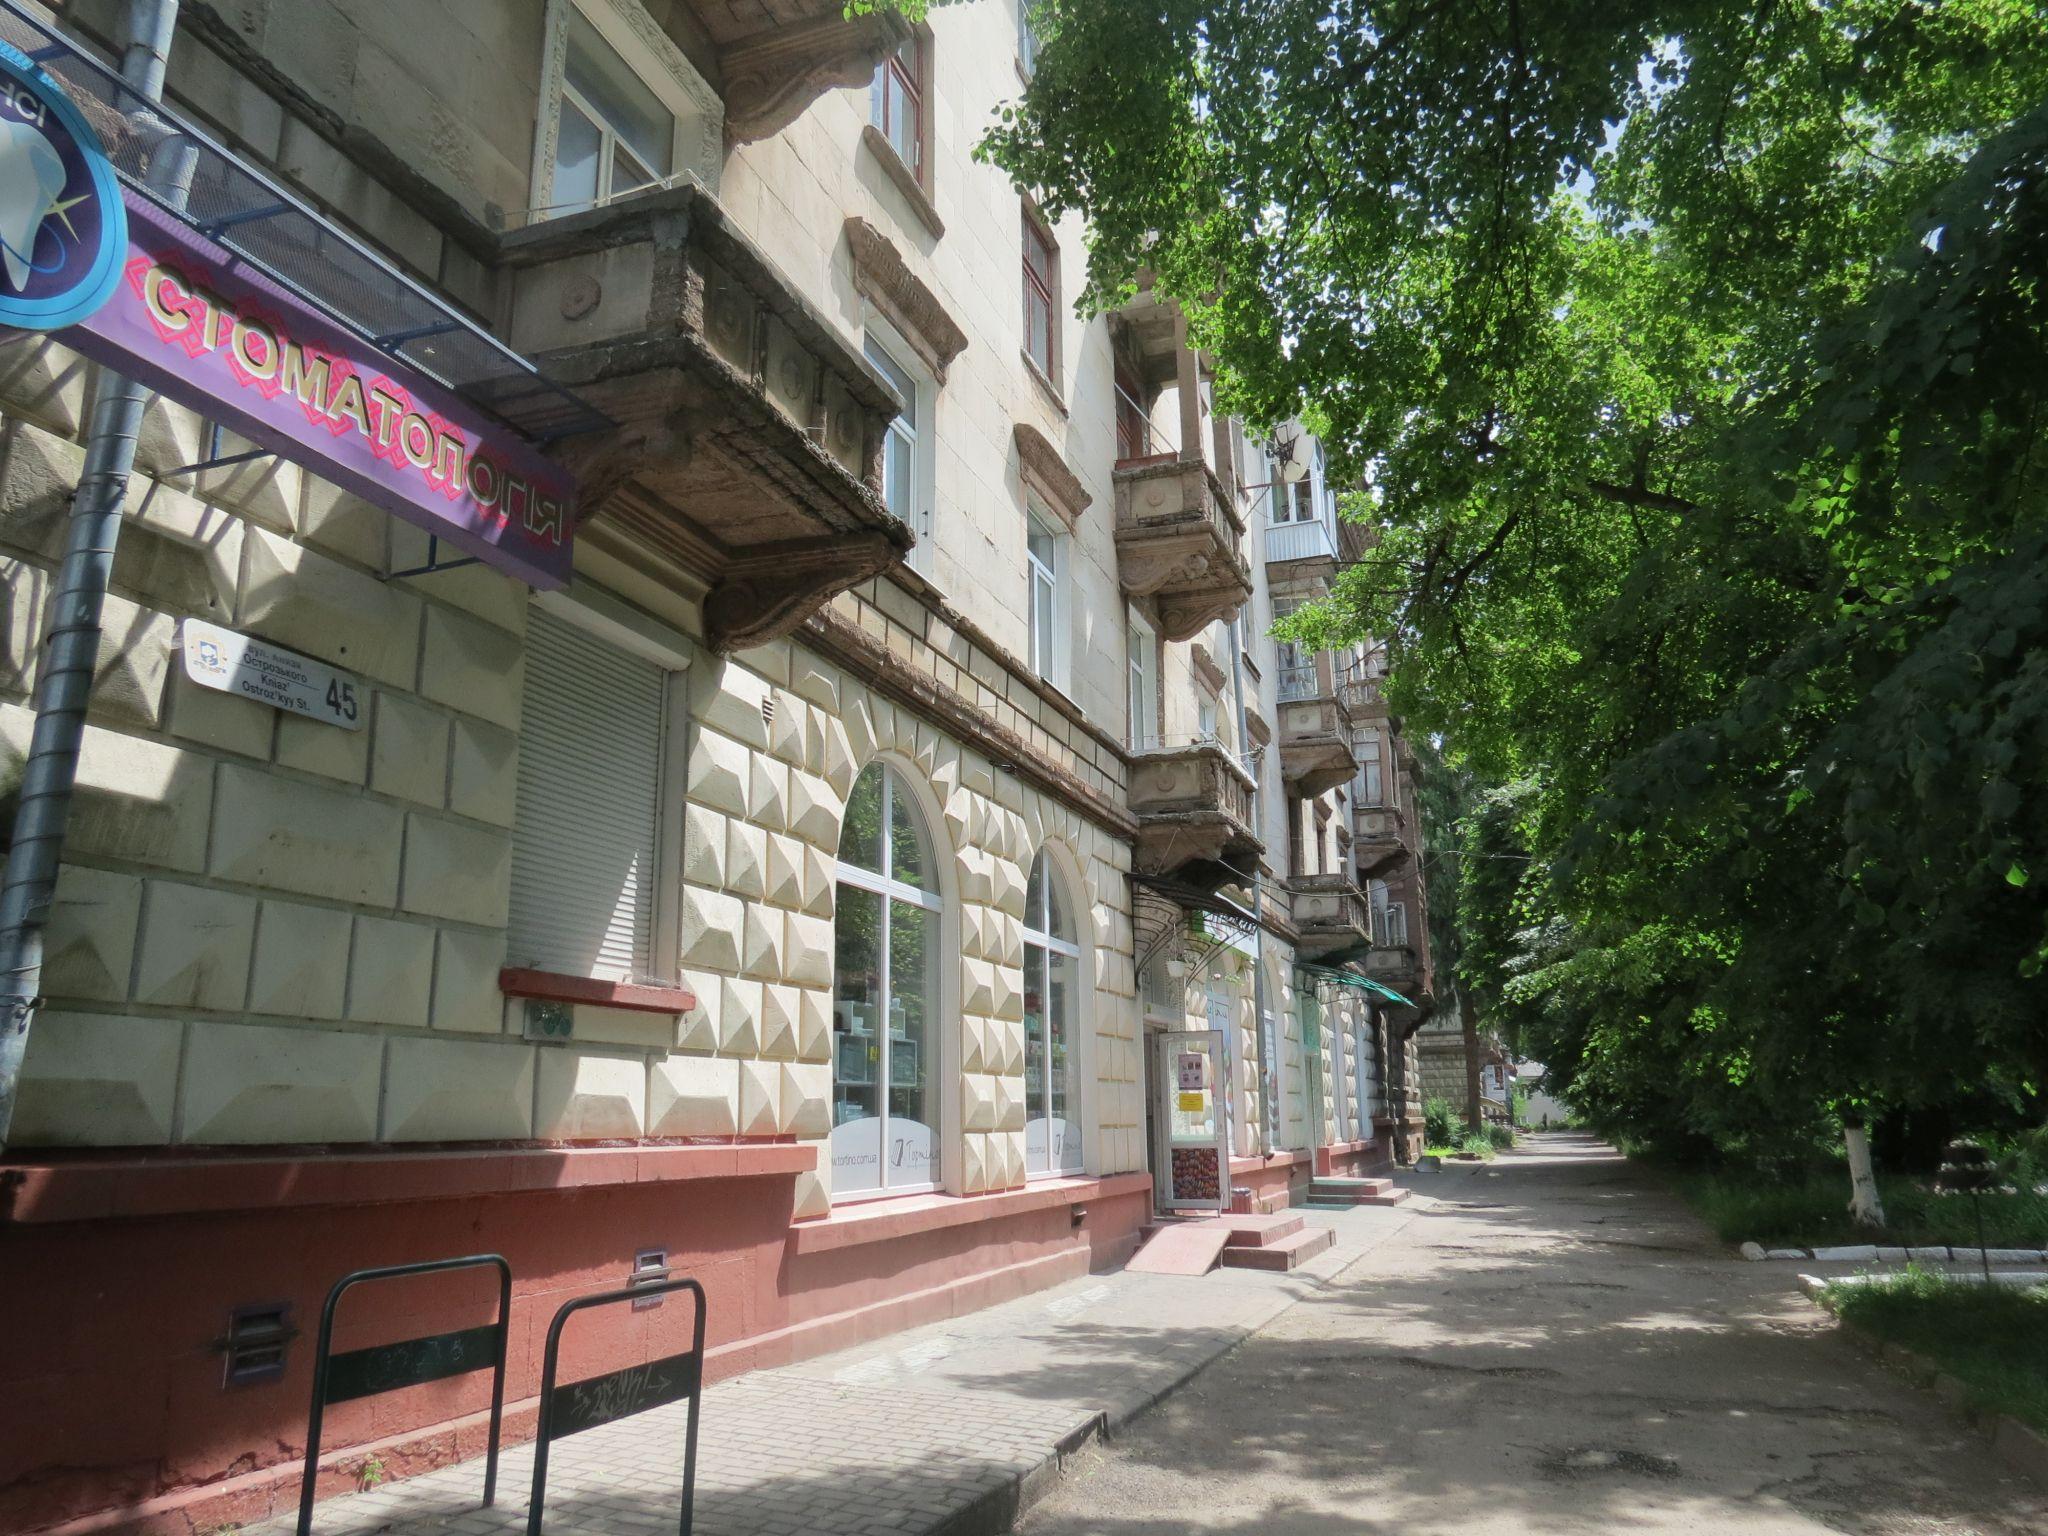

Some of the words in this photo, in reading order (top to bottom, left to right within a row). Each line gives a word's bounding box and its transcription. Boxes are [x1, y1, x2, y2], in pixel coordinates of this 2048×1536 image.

[144, 264, 563, 546] СТОМАТОЛОГІЯ
[243, 653, 308, 684] Острозького
[326, 678, 357, 721] 45
